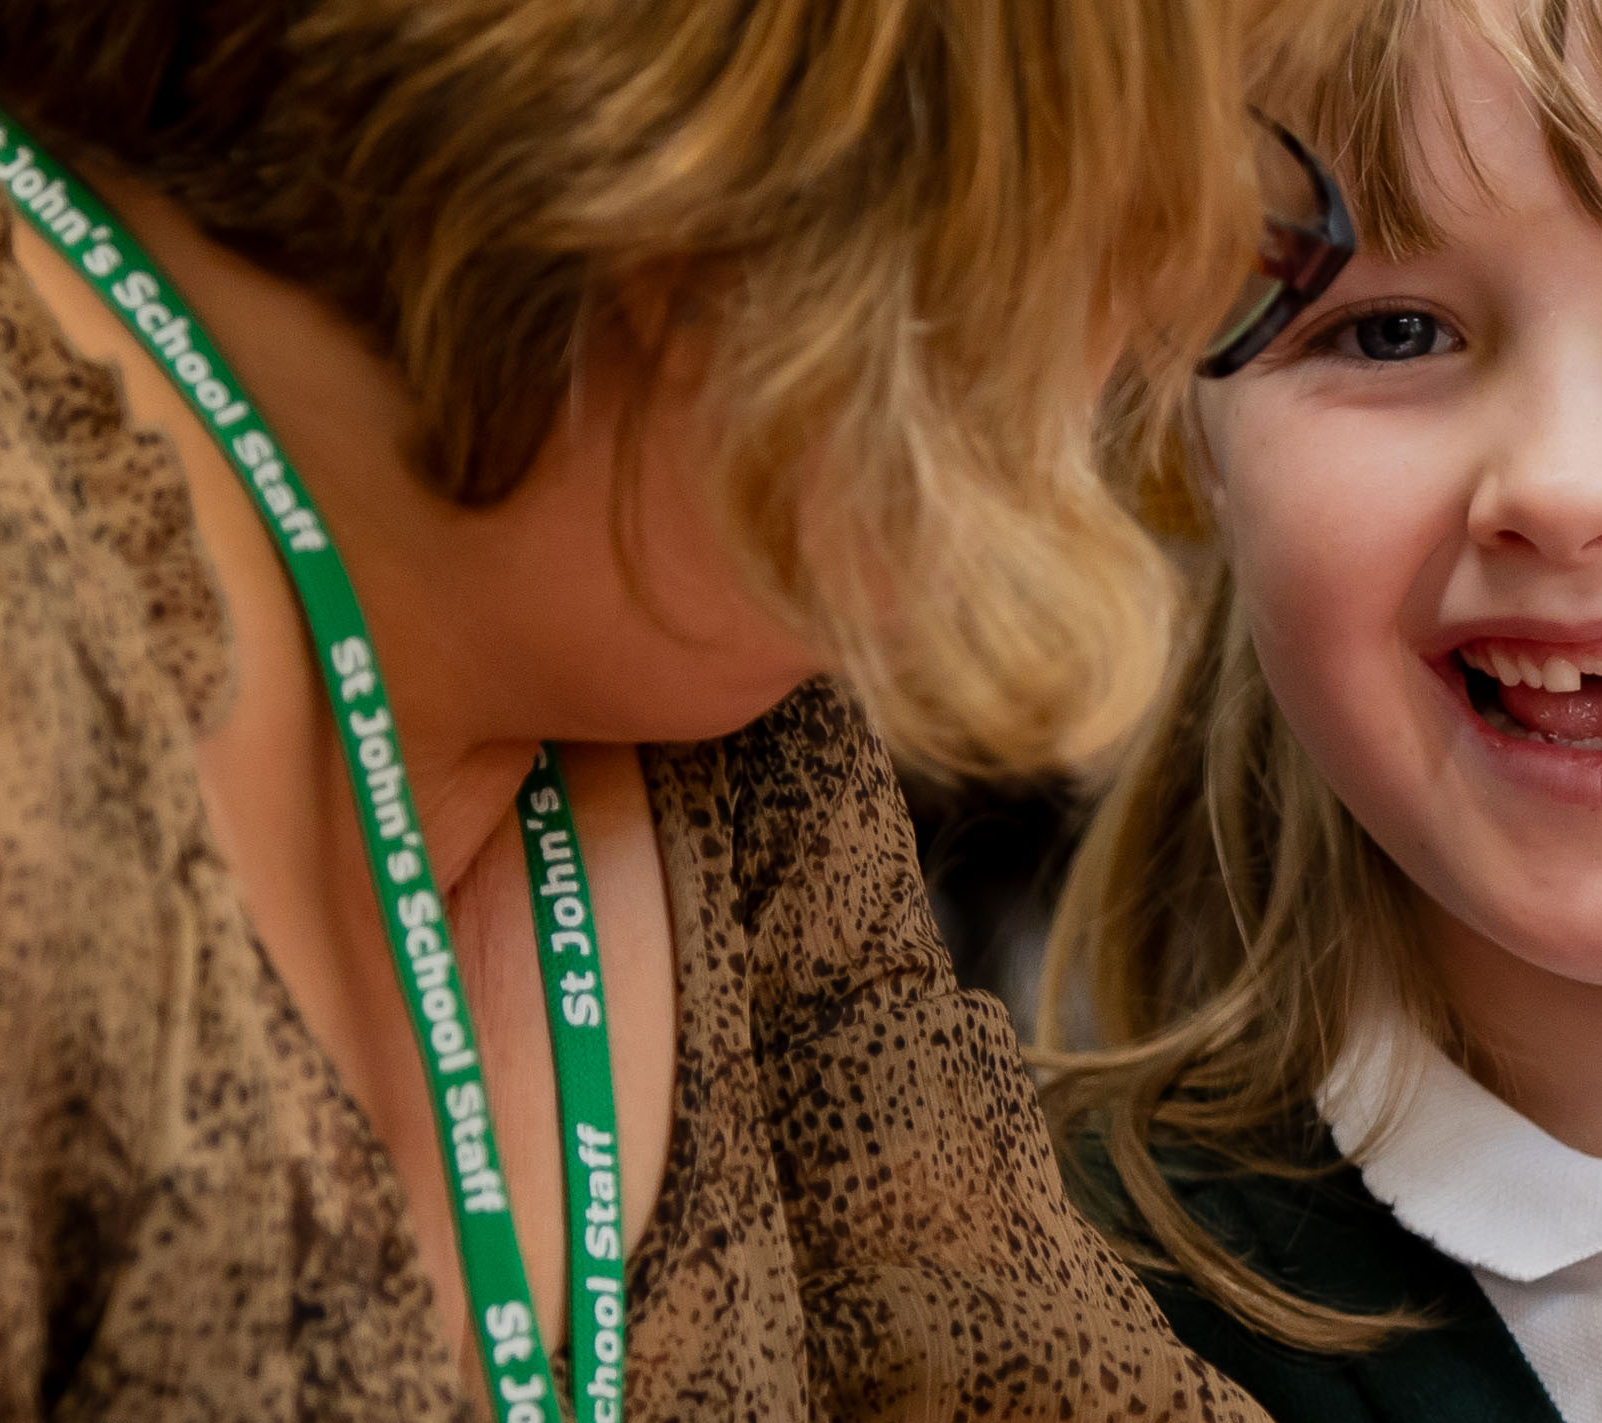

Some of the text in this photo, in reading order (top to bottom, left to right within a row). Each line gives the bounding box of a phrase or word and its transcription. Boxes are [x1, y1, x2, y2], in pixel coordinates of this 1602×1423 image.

[112, 270, 250, 429] School
[231, 429, 328, 556] Staff
[331, 636, 507, 1215] St John's School Staff
[526, 786, 601, 1028] St John's
[576, 1123, 622, 1261] Staff
[486, 1300, 535, 1367] St
